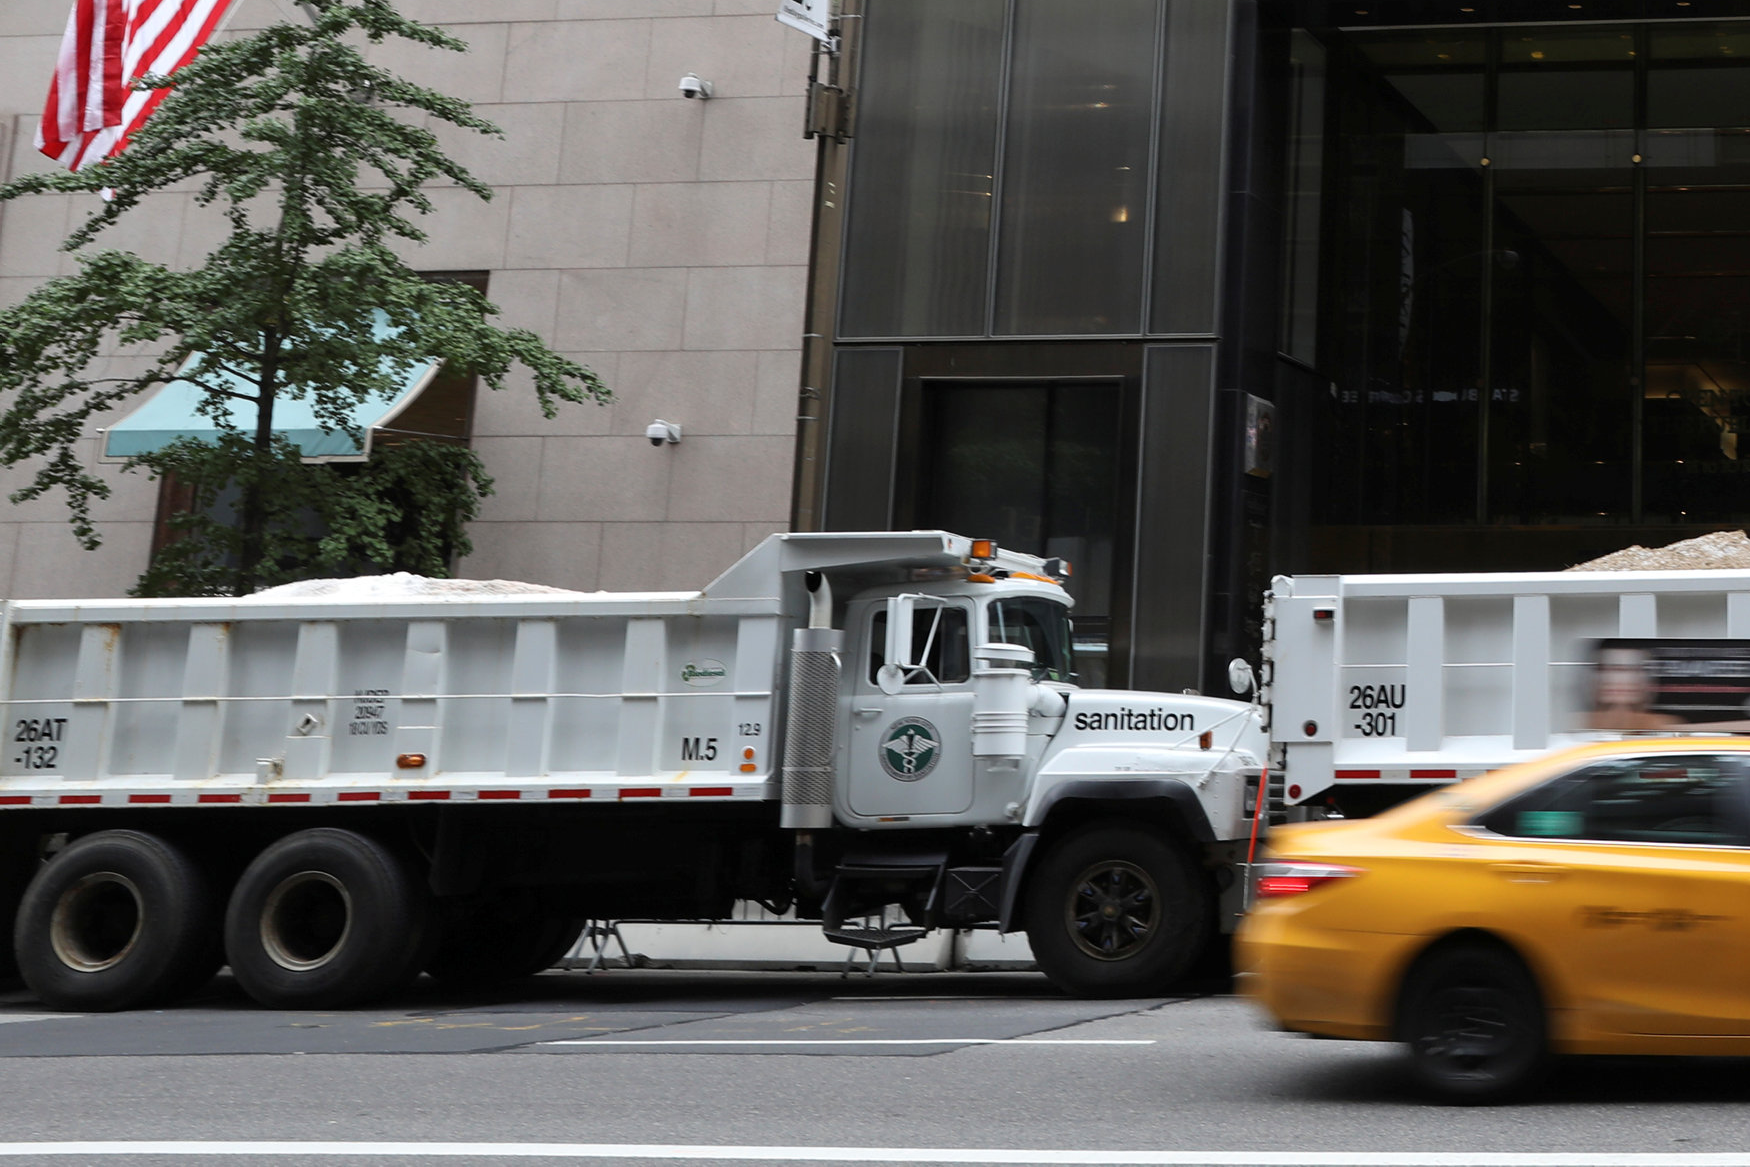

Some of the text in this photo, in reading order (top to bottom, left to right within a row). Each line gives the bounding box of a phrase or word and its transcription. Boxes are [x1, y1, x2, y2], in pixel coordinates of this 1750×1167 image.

[1349, 684, 1406, 709] 26AU
[14, 718, 67, 742] 26AT
[1074, 707, 1194, 731] sanitation
[1354, 712, 1395, 737] -301
[14, 746, 57, 769] -132
[682, 737, 718, 761] M.5
